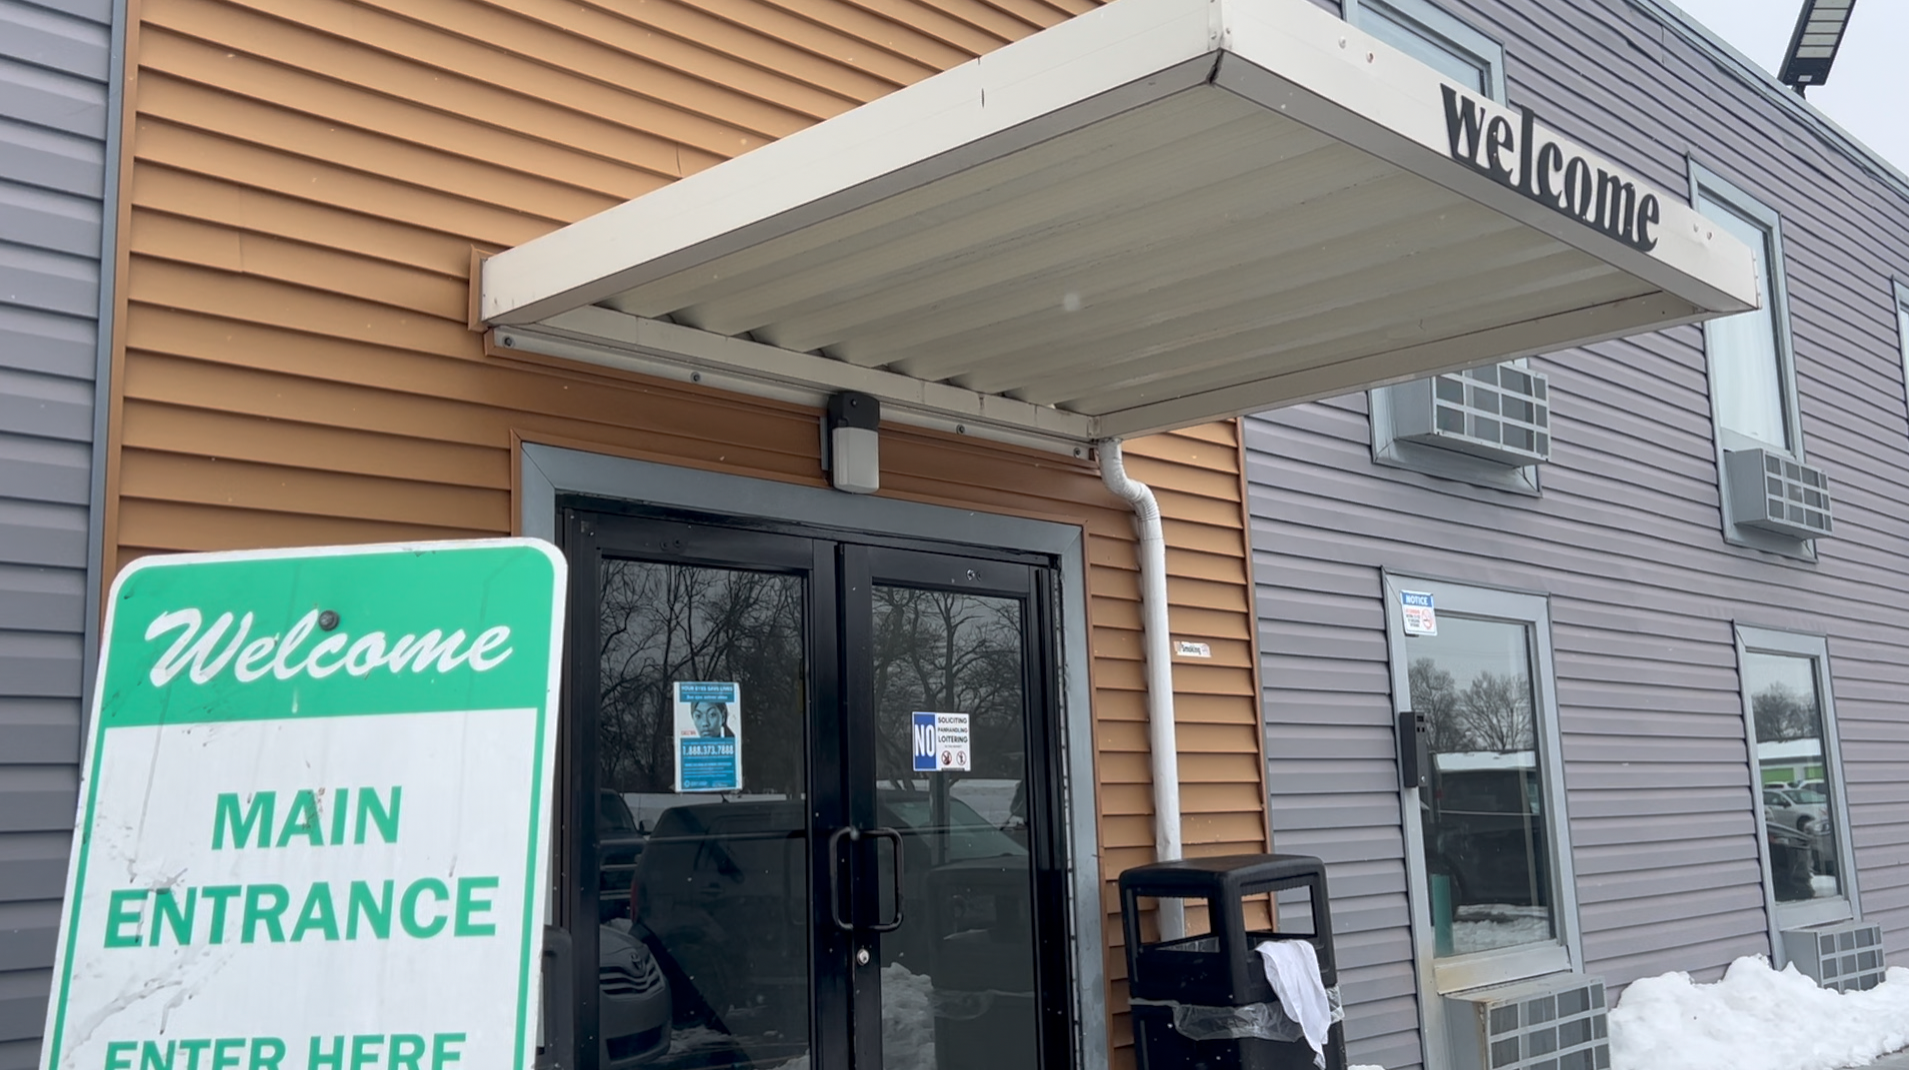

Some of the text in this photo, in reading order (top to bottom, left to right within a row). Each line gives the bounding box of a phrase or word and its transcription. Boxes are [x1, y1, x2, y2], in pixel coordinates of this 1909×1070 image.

[1440, 83, 1660, 252] welcome
[1405, 594, 1429, 606] NOTICE
[145, 607, 514, 688] Welcome
[914, 724, 936, 757] NO
[937, 735, 968, 743] LOITERING
[211, 785, 402, 851] MAIN
[103, 876, 499, 949] ENTRANCE
[104, 1036, 287, 1070] ENTER
